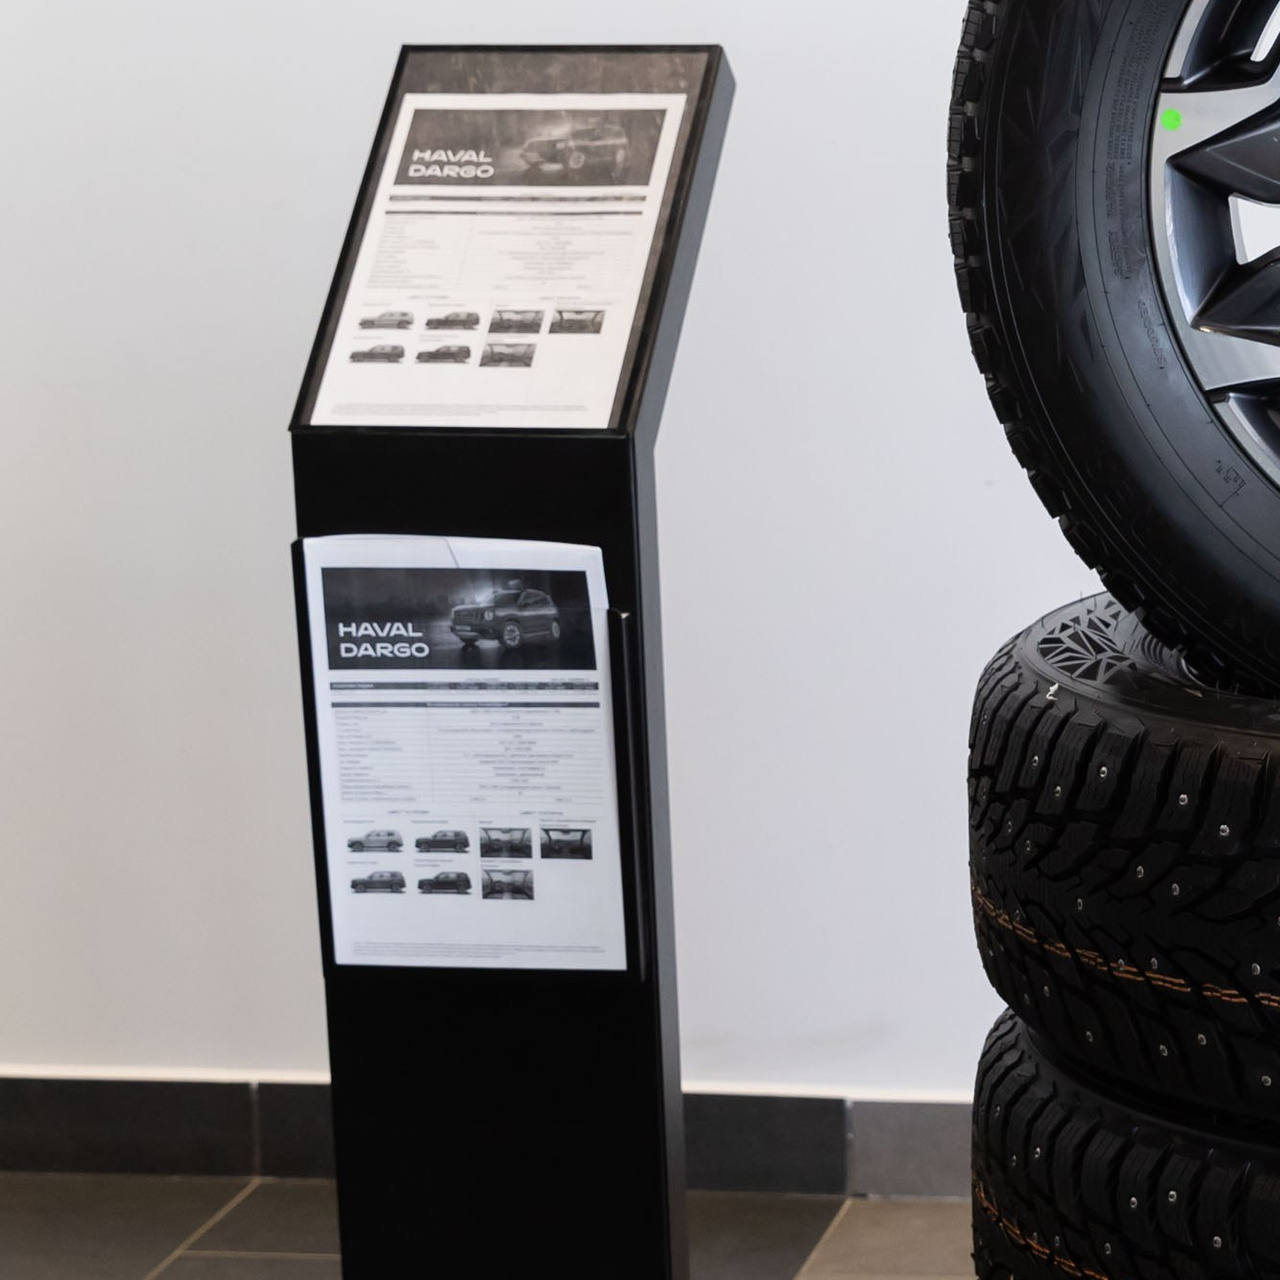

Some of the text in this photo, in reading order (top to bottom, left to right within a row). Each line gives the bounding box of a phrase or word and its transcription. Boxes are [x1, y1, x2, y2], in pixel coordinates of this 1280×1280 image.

[413, 149, 492, 163] HAVAL
[408, 164, 496, 178] DARGO
[339, 622, 423, 638] HAVAL
[341, 642, 430, 658] DARGO
